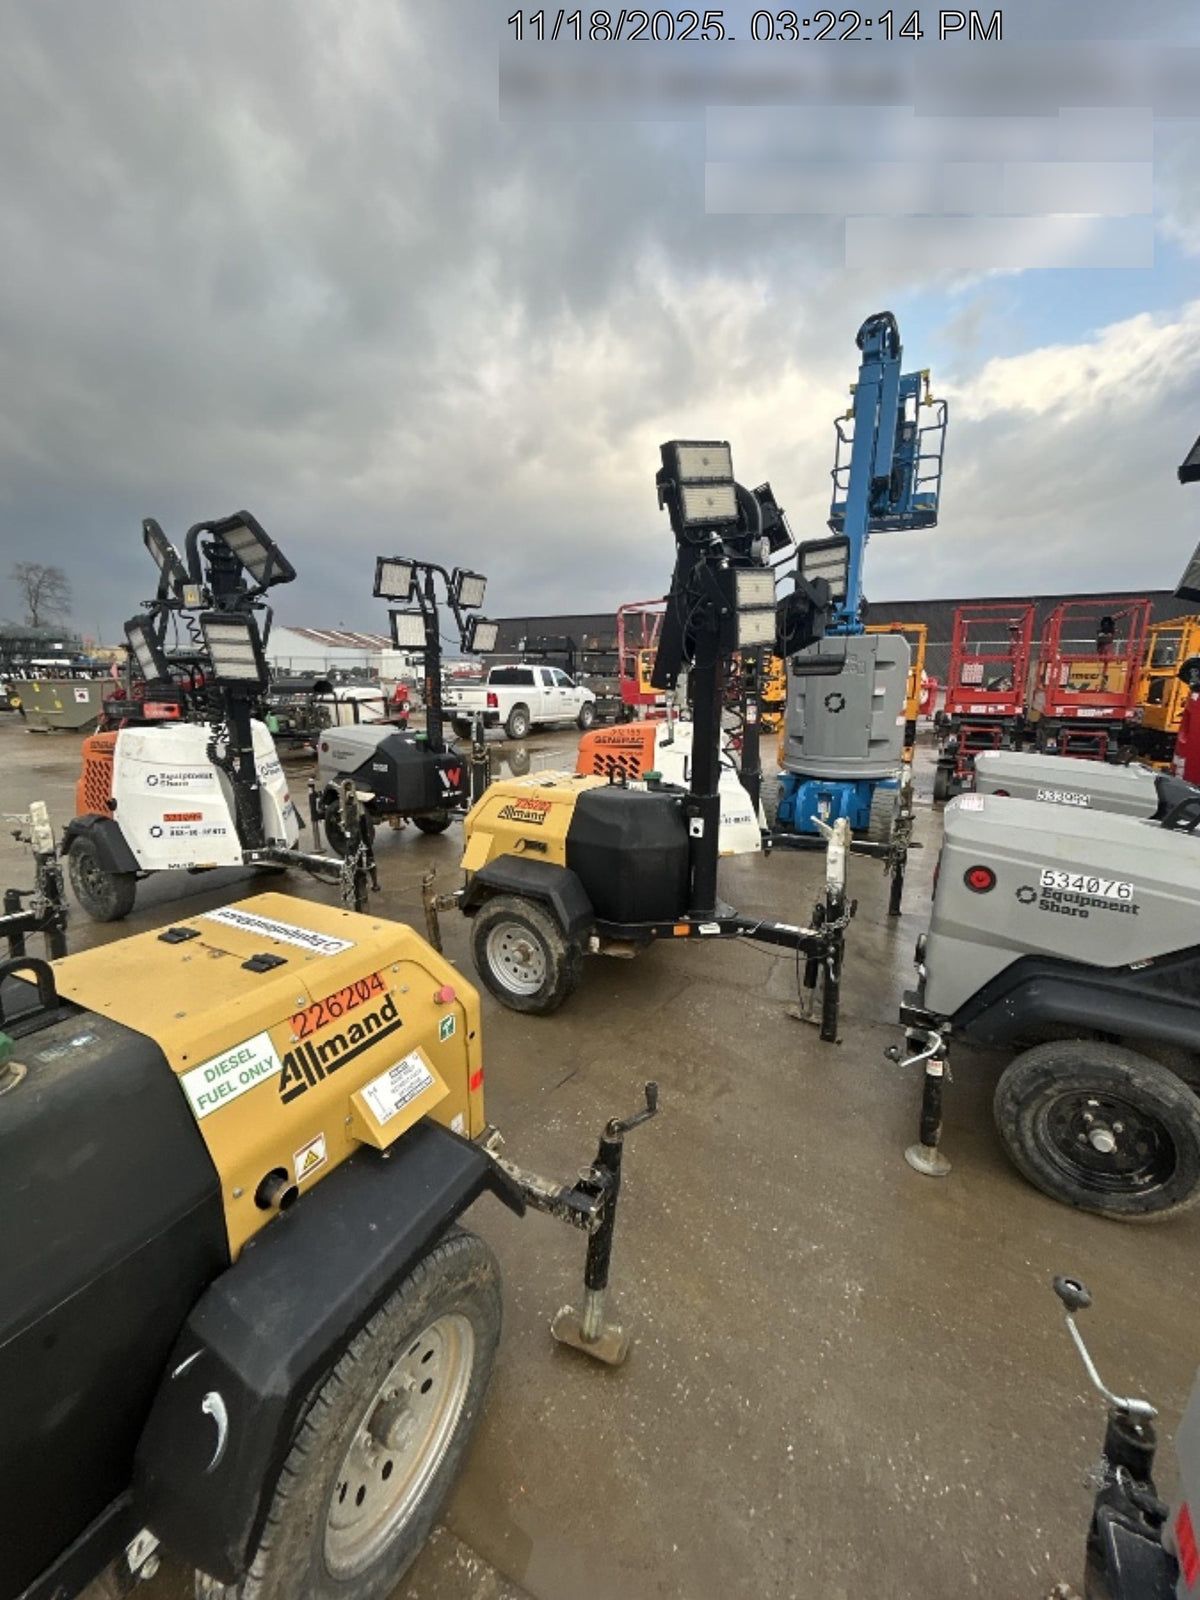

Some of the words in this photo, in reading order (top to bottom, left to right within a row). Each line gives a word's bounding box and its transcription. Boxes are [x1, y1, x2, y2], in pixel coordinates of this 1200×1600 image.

[1041, 869, 1133, 900] 534076
[1041, 886, 1141, 916] Equipment
[1038, 898, 1090, 919] Share
[291, 972, 387, 1040] 226204
[202, 1047, 258, 1084] DIESEL
[278, 993, 402, 1102] Allmand
[196, 1079, 238, 1111] FUEL
[239, 1054, 275, 1091] ONLY
